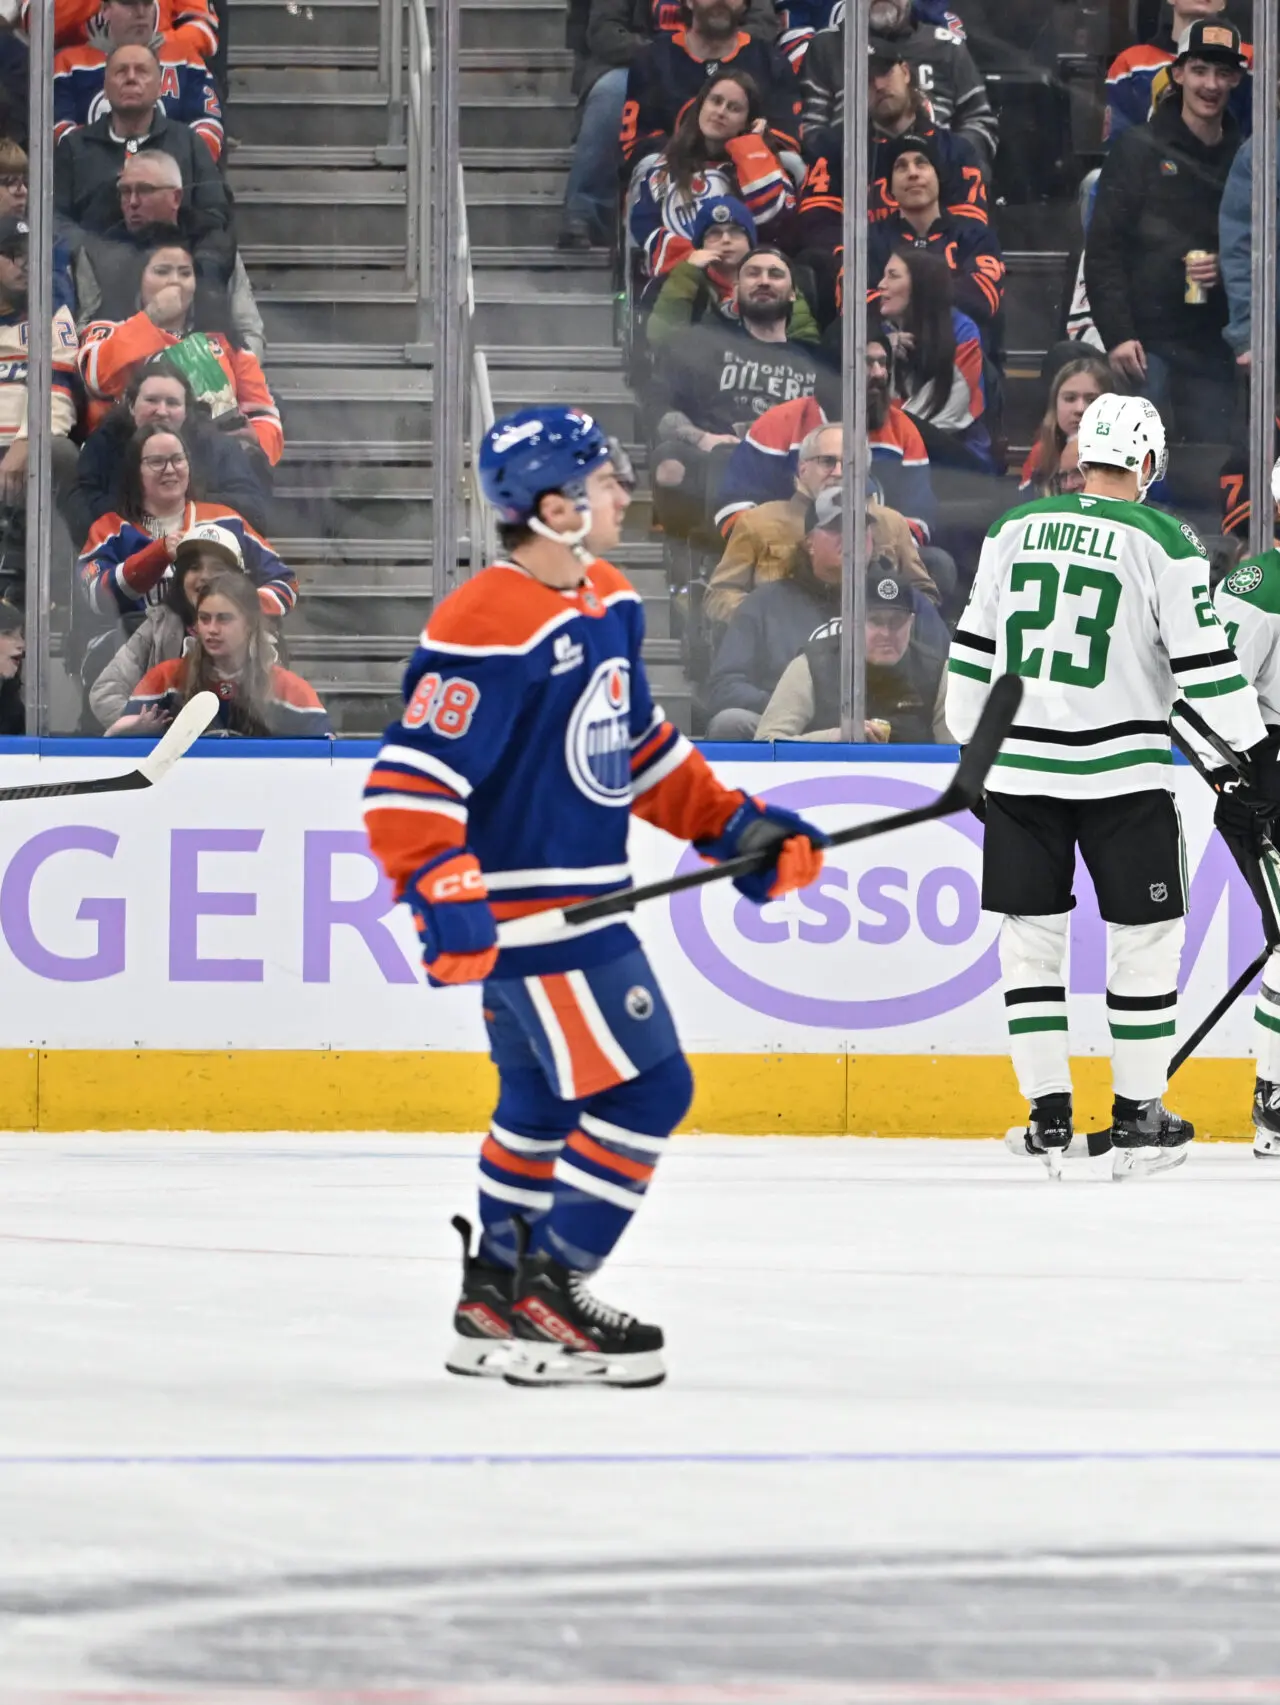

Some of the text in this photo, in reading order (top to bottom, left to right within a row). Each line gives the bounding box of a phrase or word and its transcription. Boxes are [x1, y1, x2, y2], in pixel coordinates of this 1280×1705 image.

[919, 64, 934, 90] C
[801, 157, 831, 193] 4
[1096, 421, 1111, 436] 23
[1023, 523, 1117, 561] LINDELL
[1005, 562, 1123, 689] 23
[1191, 585, 1222, 628] 2
[402, 672, 481, 740] 88
[433, 869, 483, 898] CC
[0, 825, 483, 986] GER
